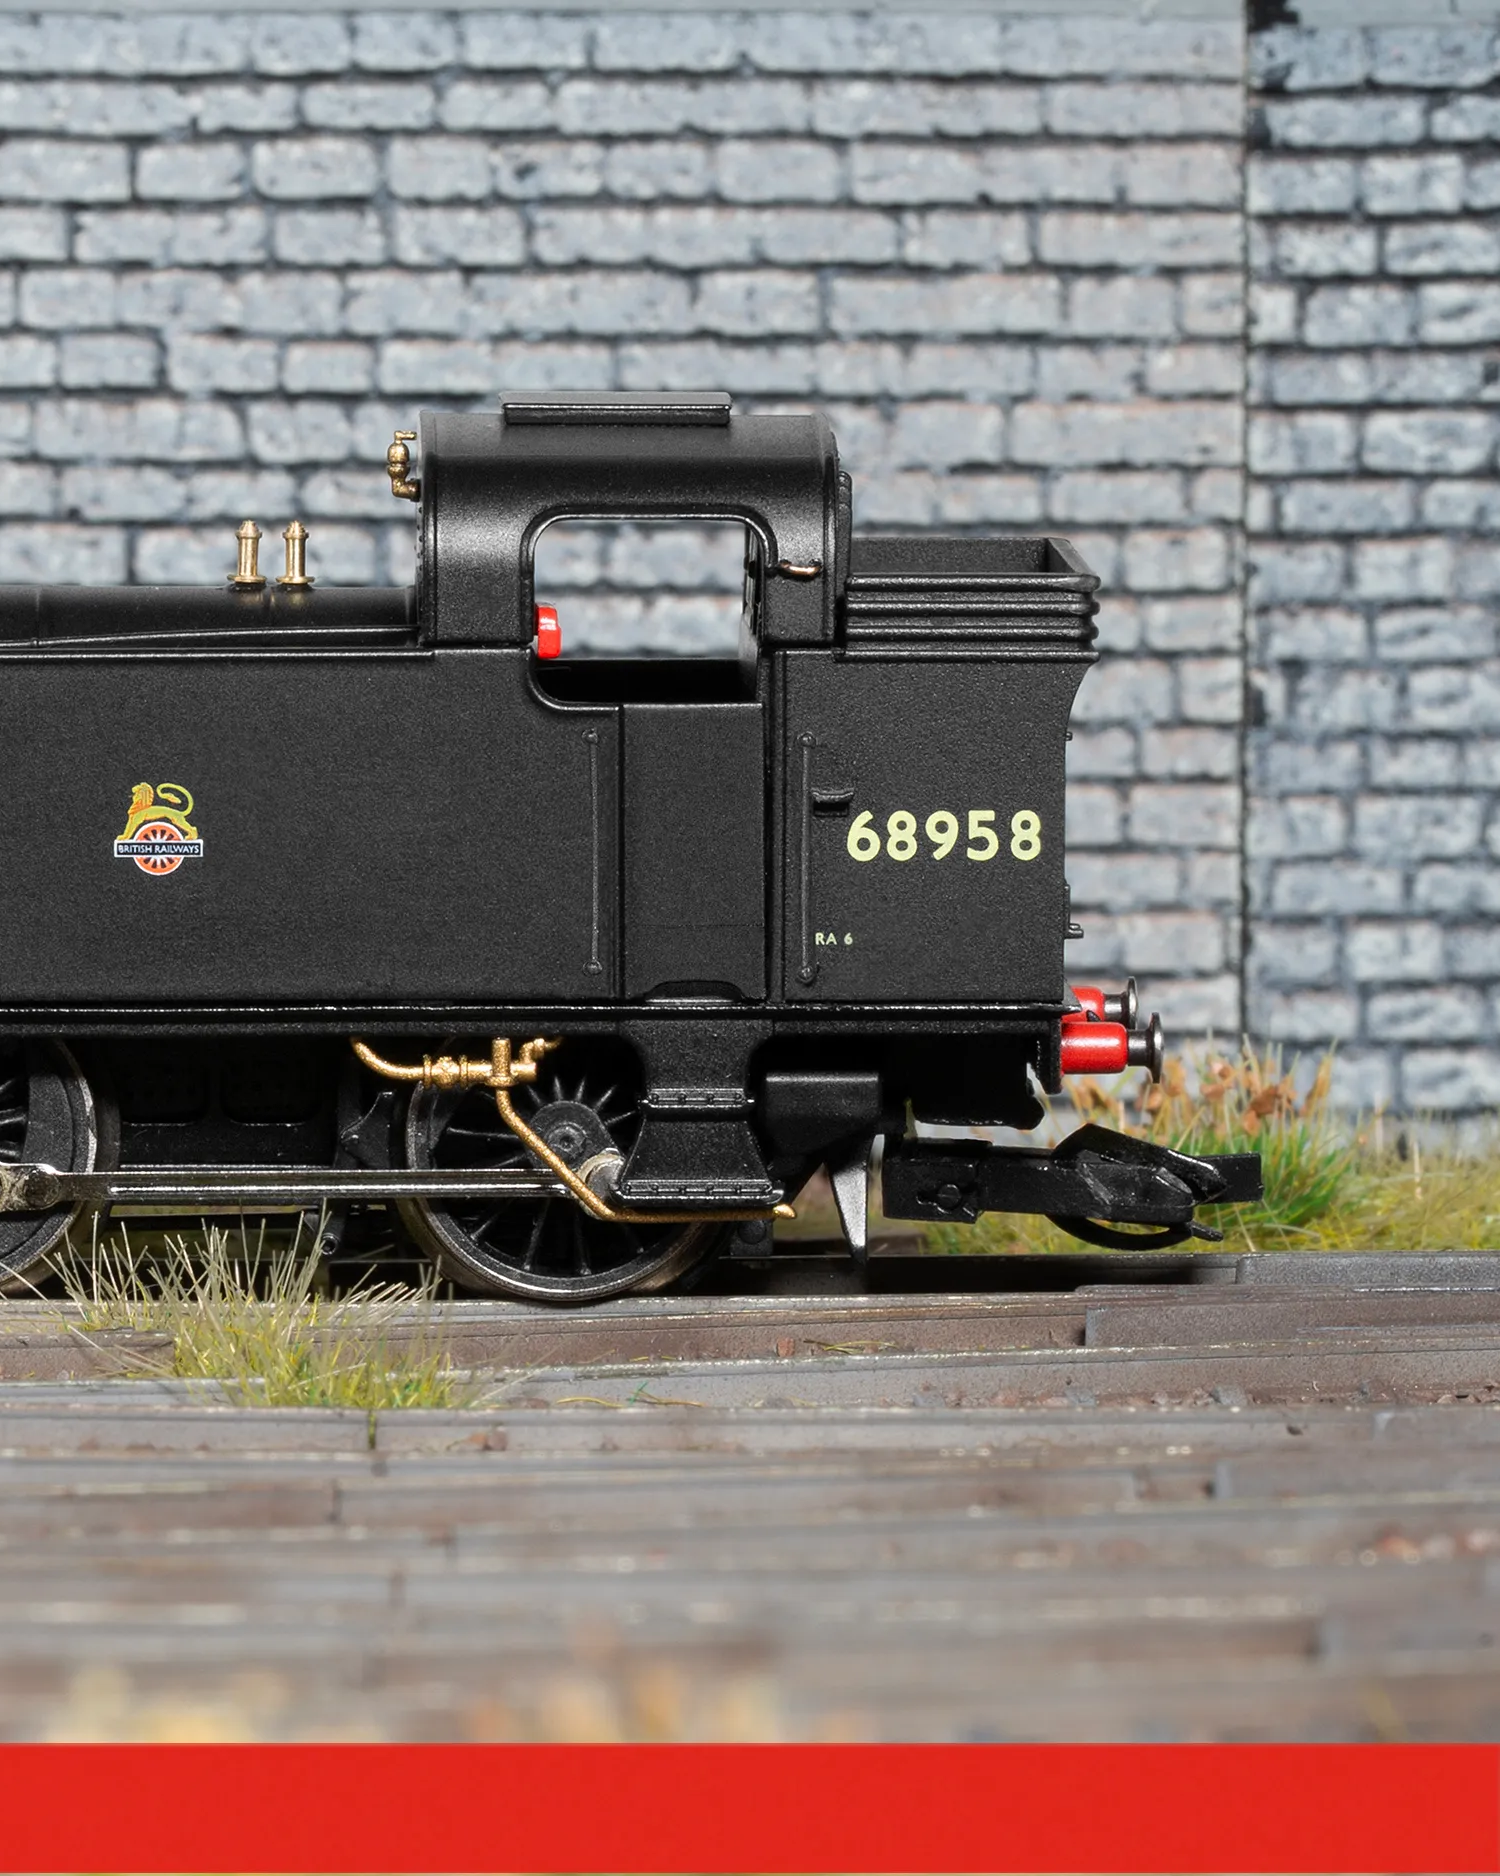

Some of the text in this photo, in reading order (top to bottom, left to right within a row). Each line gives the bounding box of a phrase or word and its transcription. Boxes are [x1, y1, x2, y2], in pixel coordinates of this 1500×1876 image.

[846, 810, 1041, 861] 68958
[118, 844, 200, 854] BRITISH RAILWAYS
[815, 932, 854, 946] RA 6
